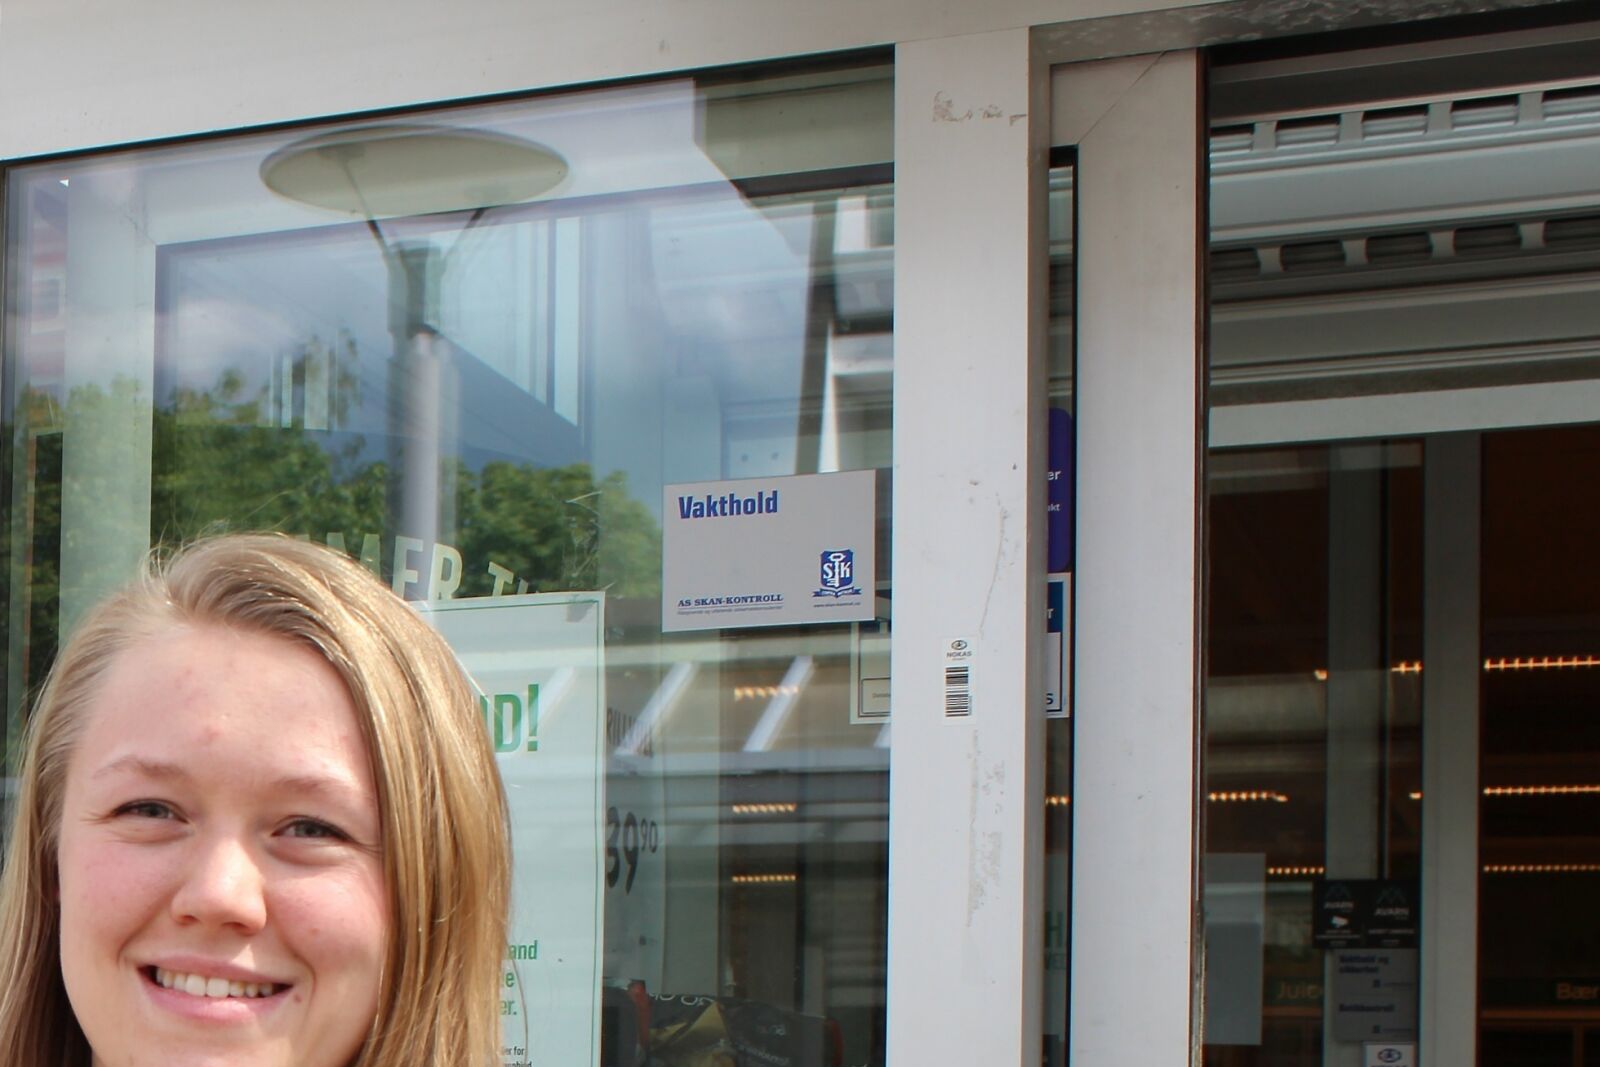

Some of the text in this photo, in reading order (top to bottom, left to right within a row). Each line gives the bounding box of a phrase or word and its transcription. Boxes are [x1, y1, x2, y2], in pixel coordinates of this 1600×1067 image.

[678, 490, 779, 520] Vakthold
[678, 593, 784, 607] AS SKAN-KONTROLL
[946, 650, 972, 658] NOKAS
